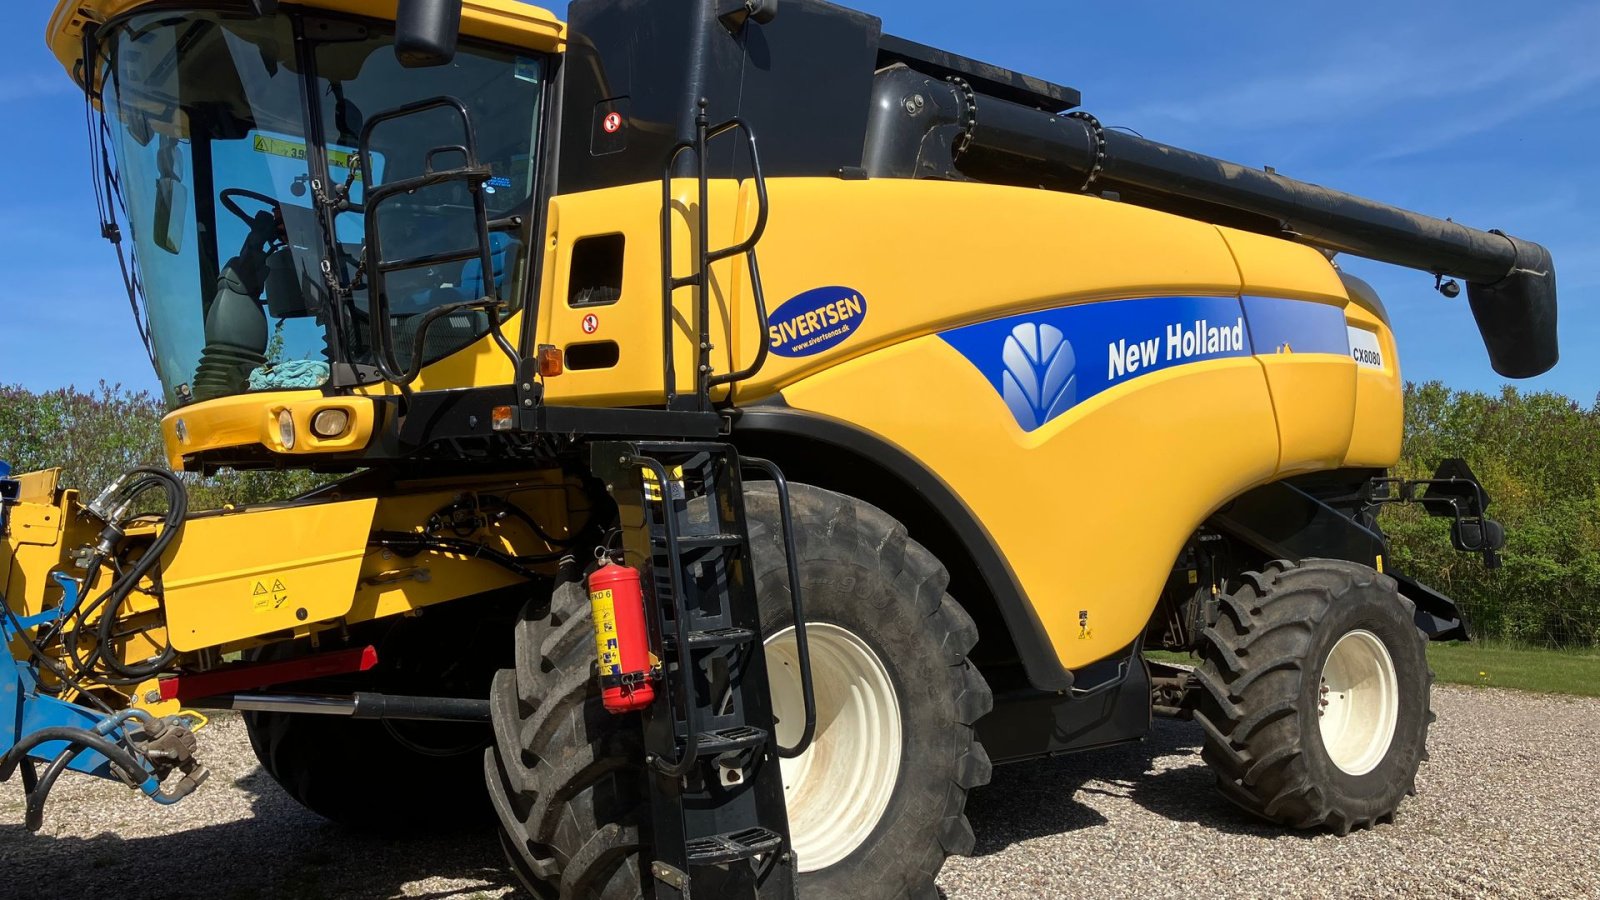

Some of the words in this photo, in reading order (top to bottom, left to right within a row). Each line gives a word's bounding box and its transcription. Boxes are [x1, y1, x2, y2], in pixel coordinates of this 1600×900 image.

[768, 294, 862, 348] SIVERTSEN
[791, 323, 850, 353] www.sivertsenas.dk
[1108, 337, 1160, 381] New
[1166, 317, 1243, 361] Holland
[1353, 347, 1381, 366] CX8080
[605, 590, 611, 598] 6
